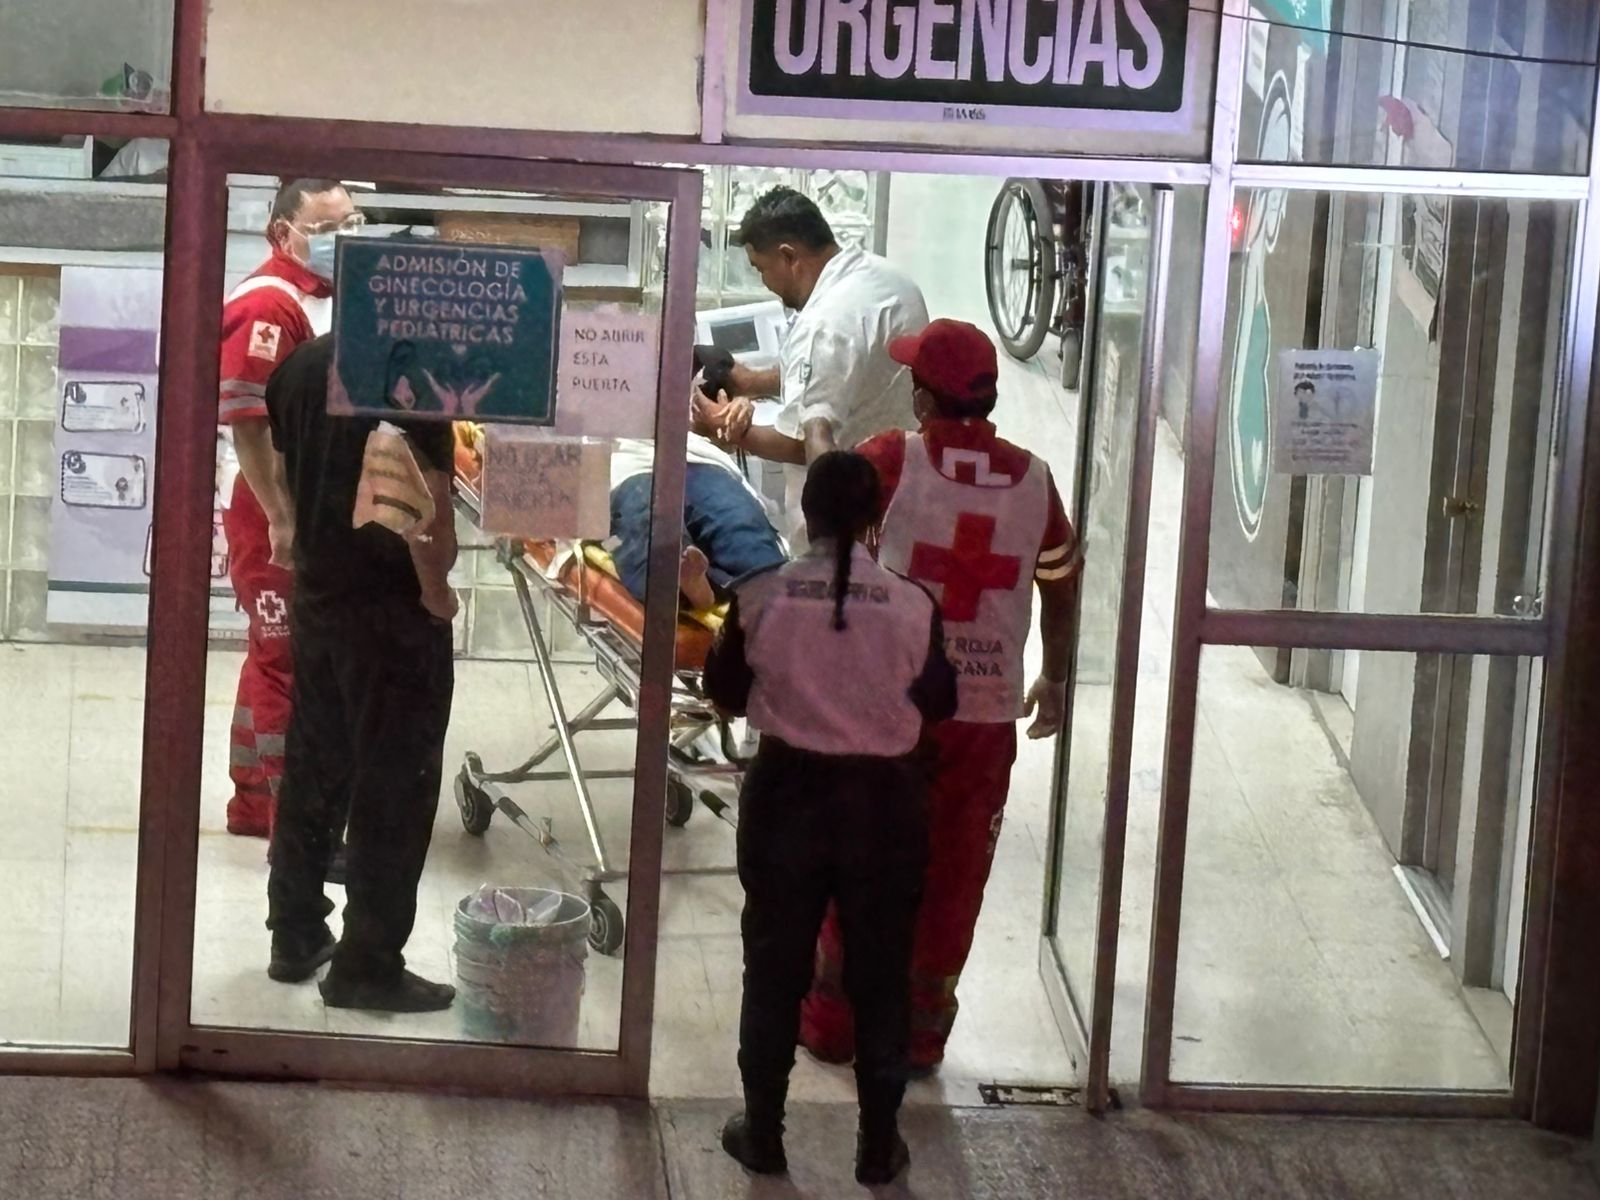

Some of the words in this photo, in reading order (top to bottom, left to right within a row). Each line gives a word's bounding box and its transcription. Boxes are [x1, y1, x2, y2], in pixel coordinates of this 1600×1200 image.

[774, 0, 1164, 90] URGENCIAS
[495, 261, 521, 279] DE
[368, 275, 528, 301] GINECOLOGÍA
[375, 298, 387, 314] Y
[394, 298, 519, 324] URGENCIAS
[574, 328, 597, 343] NO
[573, 351, 609, 367] ESTA
[573, 376, 631, 393] PUERTA
[956, 637, 1003, 655] ROJA
[954, 660, 1003, 677] CANA
